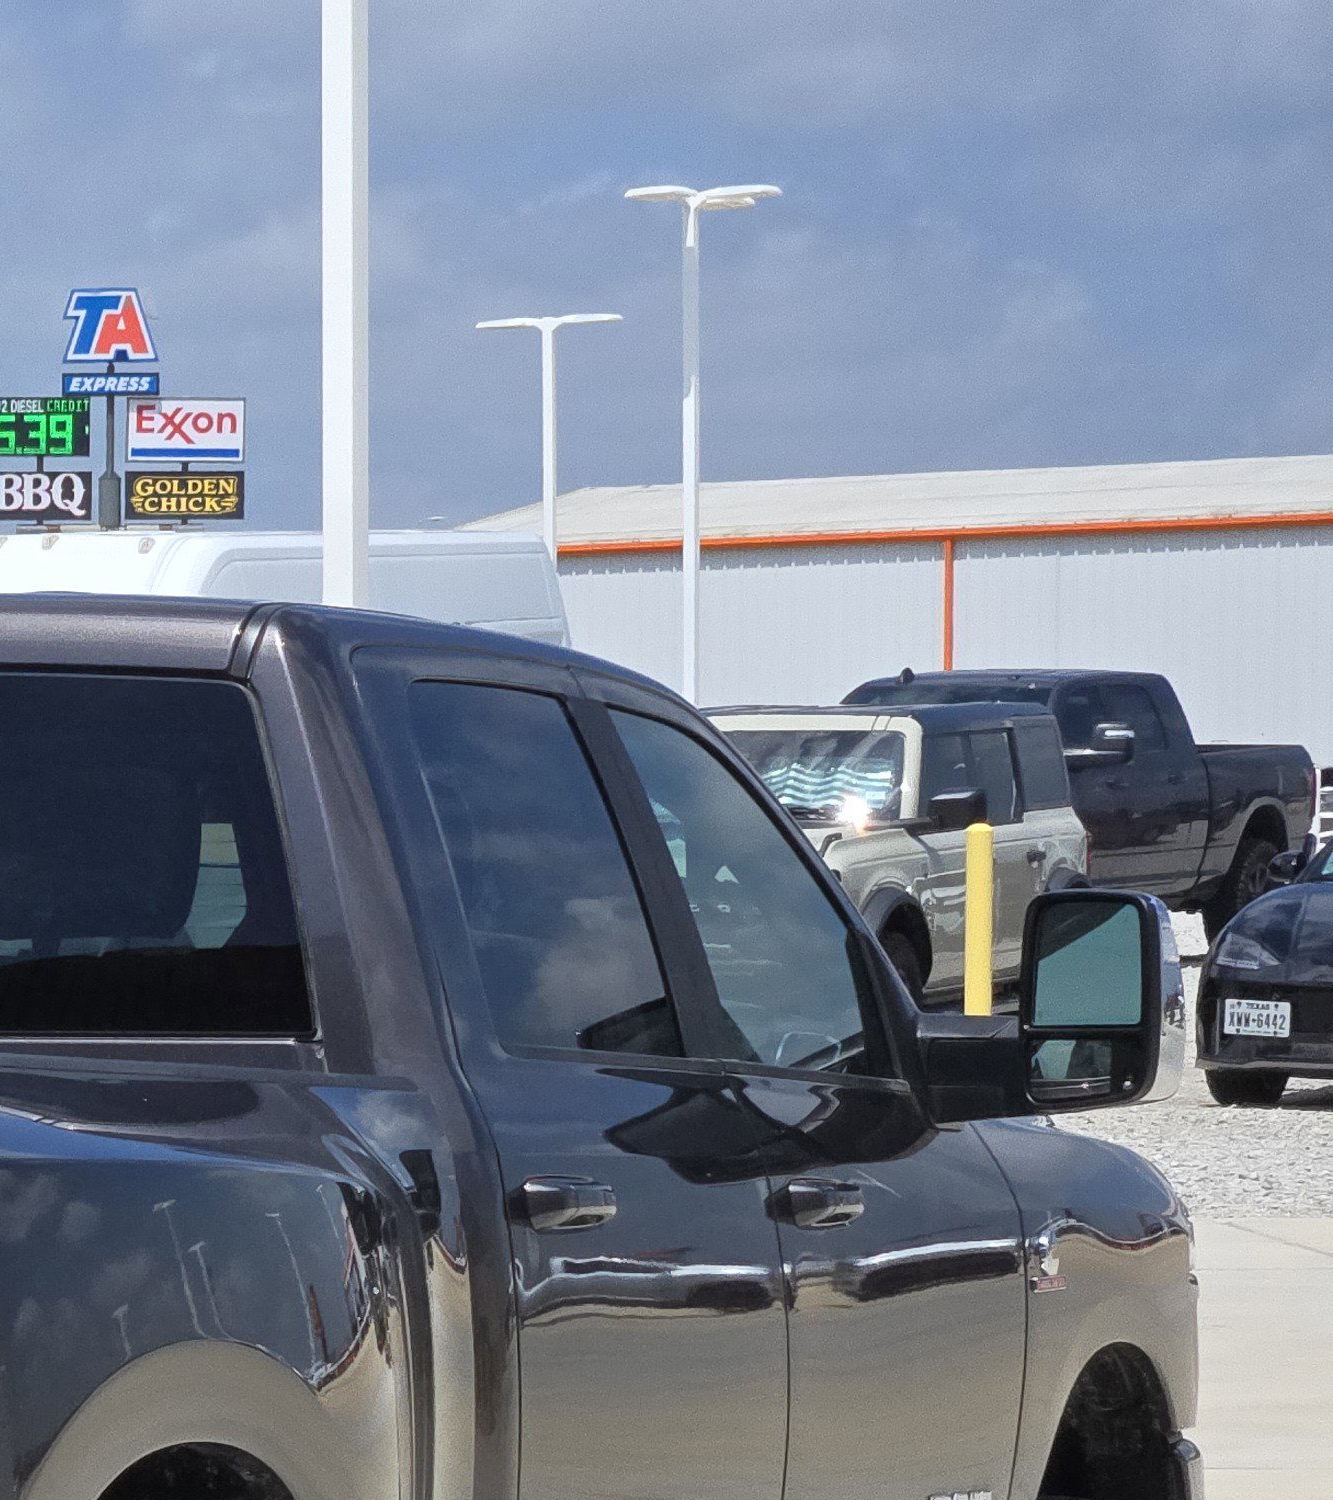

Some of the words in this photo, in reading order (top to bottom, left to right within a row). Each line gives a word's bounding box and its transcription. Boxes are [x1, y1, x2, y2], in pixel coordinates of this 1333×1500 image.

[72, 294, 149, 355] TA
[69, 377, 151, 392] EXPRESS
[10, 400, 44, 413] DIESEL
[46, 399, 89, 412] CREDIT
[135, 478, 235, 496] GOLDEN
[143, 496, 224, 512] CHICK
